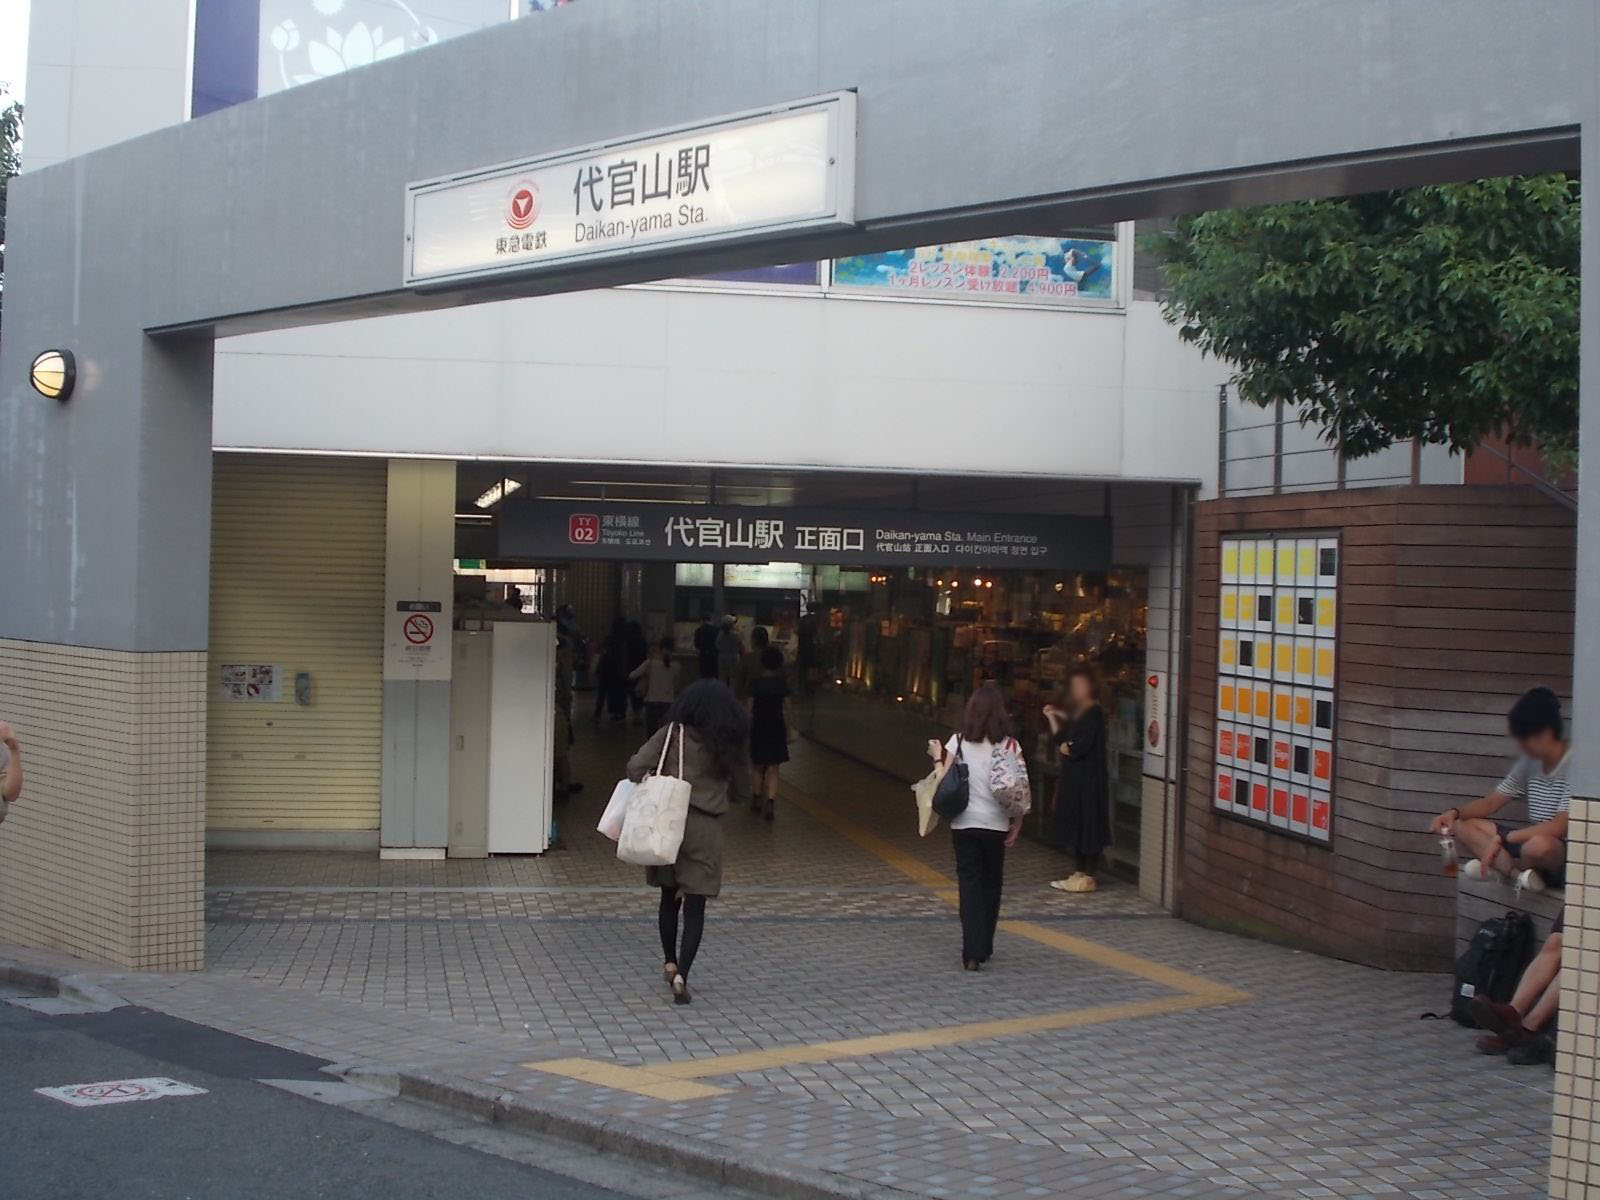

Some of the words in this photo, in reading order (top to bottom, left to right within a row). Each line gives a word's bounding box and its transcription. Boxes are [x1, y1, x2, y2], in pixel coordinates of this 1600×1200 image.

[573, 144, 711, 216] 代官山駅
[575, 211, 673, 244] Daikan-yama
[678, 204, 709, 227] Sta.
[496, 231, 548, 255] 東急電鉄
[578, 517, 591, 526] TY
[575, 528, 593, 540] 02
[629, 530, 645, 538] Line
[664, 516, 784, 550] 代官山駅
[794, 526, 864, 552] 正面口
[876, 529, 942, 543] Daikan-yama
[944, 531, 963, 541] Sta.
[967, 532, 991, 542] Main
[994, 532, 1038, 544] Entrance
